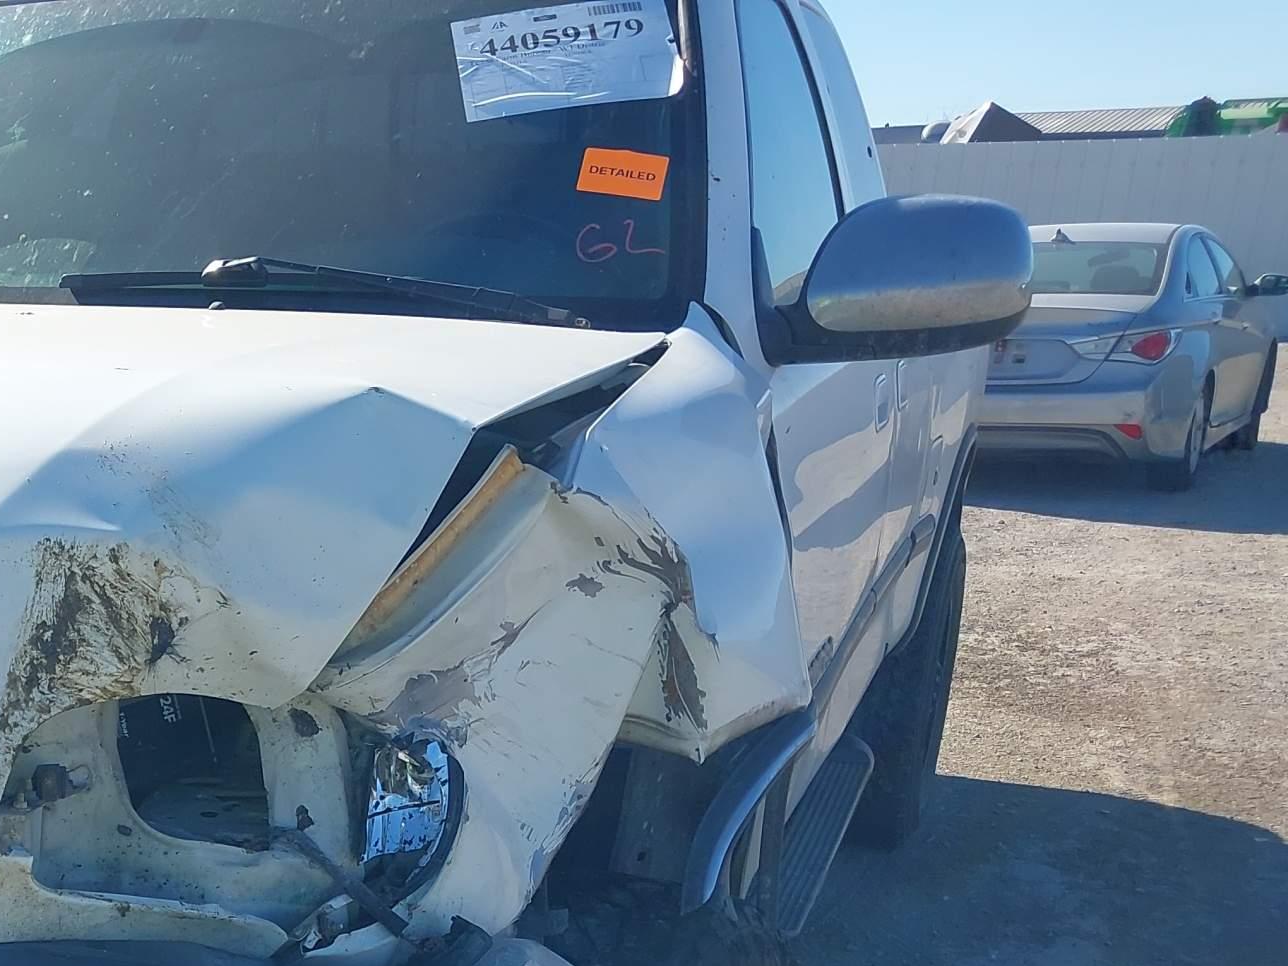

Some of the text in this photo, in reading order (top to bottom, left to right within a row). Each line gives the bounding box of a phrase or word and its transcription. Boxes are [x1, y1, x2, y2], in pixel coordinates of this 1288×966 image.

[479, 18, 644, 56] 44059179
[589, 163, 656, 182] DETAILED
[159, 695, 176, 722] 24F
